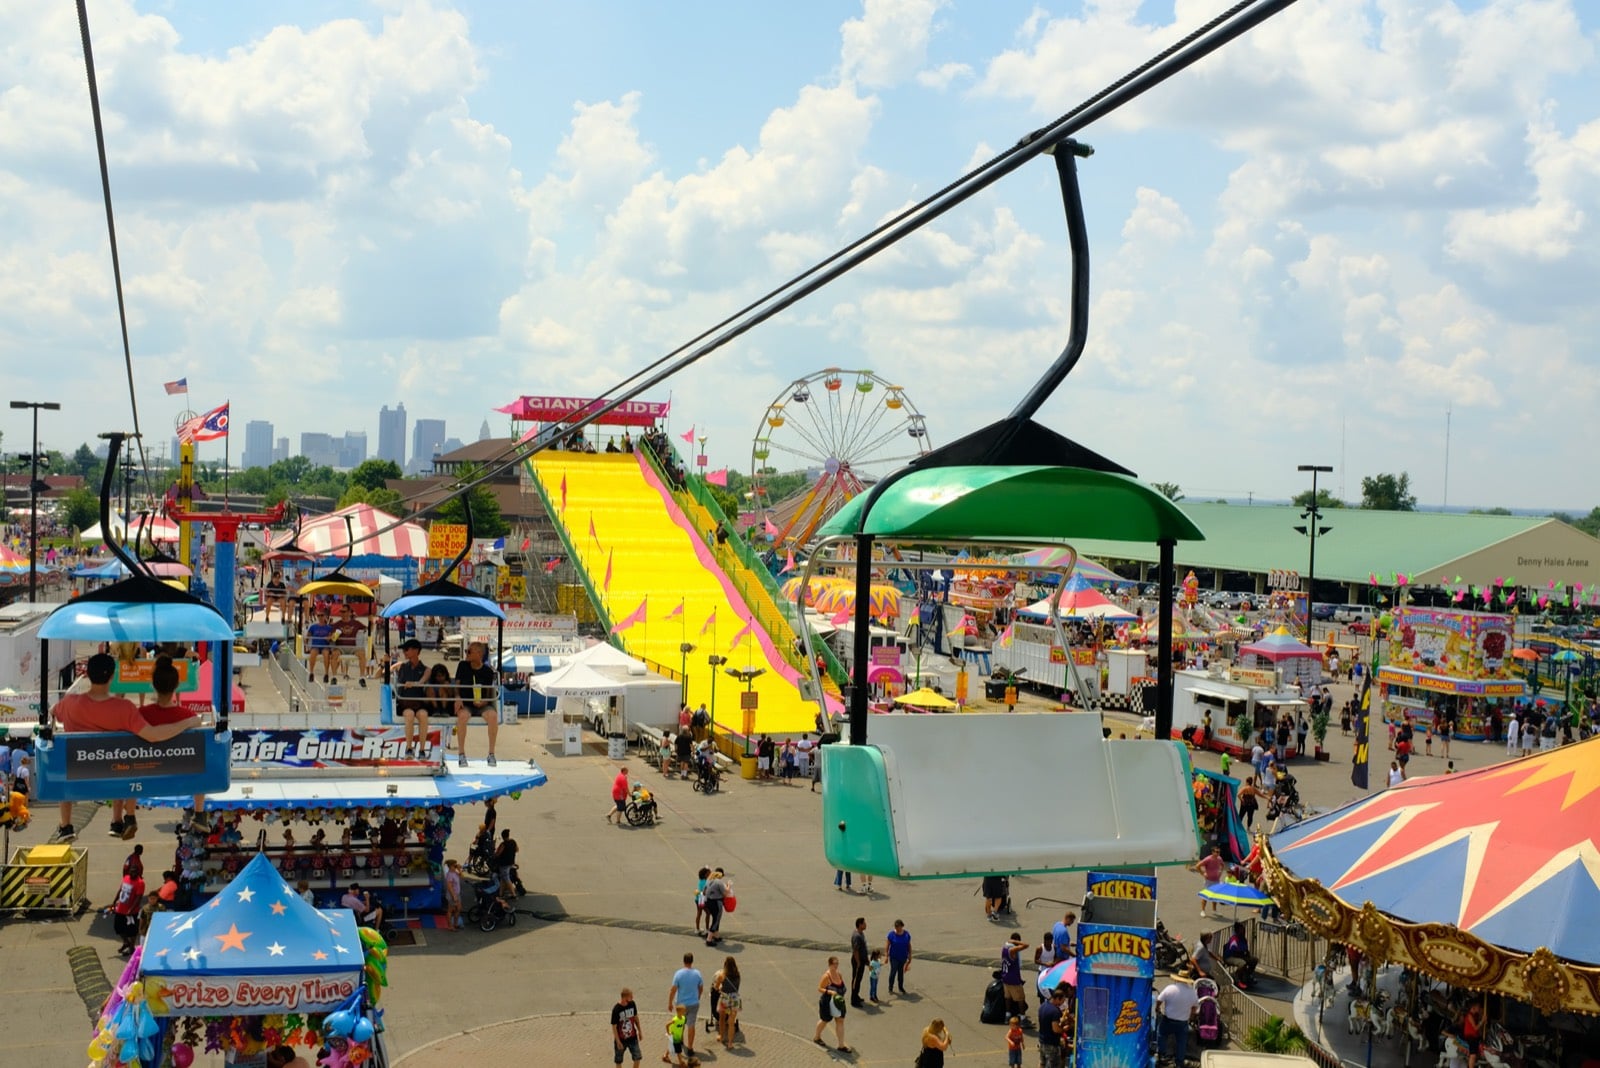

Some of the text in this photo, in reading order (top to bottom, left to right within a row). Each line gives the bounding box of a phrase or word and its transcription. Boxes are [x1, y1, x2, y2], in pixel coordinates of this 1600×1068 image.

[528, 398, 591, 411] GIANT
[1517, 556, 1542, 567] Denny
[1567, 557, 1589, 567] Arena
[490, 620, 526, 628] FENCH
[512, 644, 536, 653] GIANT
[1254, 678, 1272, 686] FRIES
[1418, 677, 1455, 689] LEMONADE
[580, 689, 610, 697] Cream
[1506, 685, 1523, 693] CAKES
[76, 746, 196, 761] BeSafeOhio.com
[231, 739, 288, 761] ater
[296, 737, 352, 761] Gun
[129, 783, 143, 792] 75
[1091, 879, 1153, 900] TICKETS
[1081, 931, 1153, 961] TICKETS
[172, 977, 355, 1006] Prize Every Time
